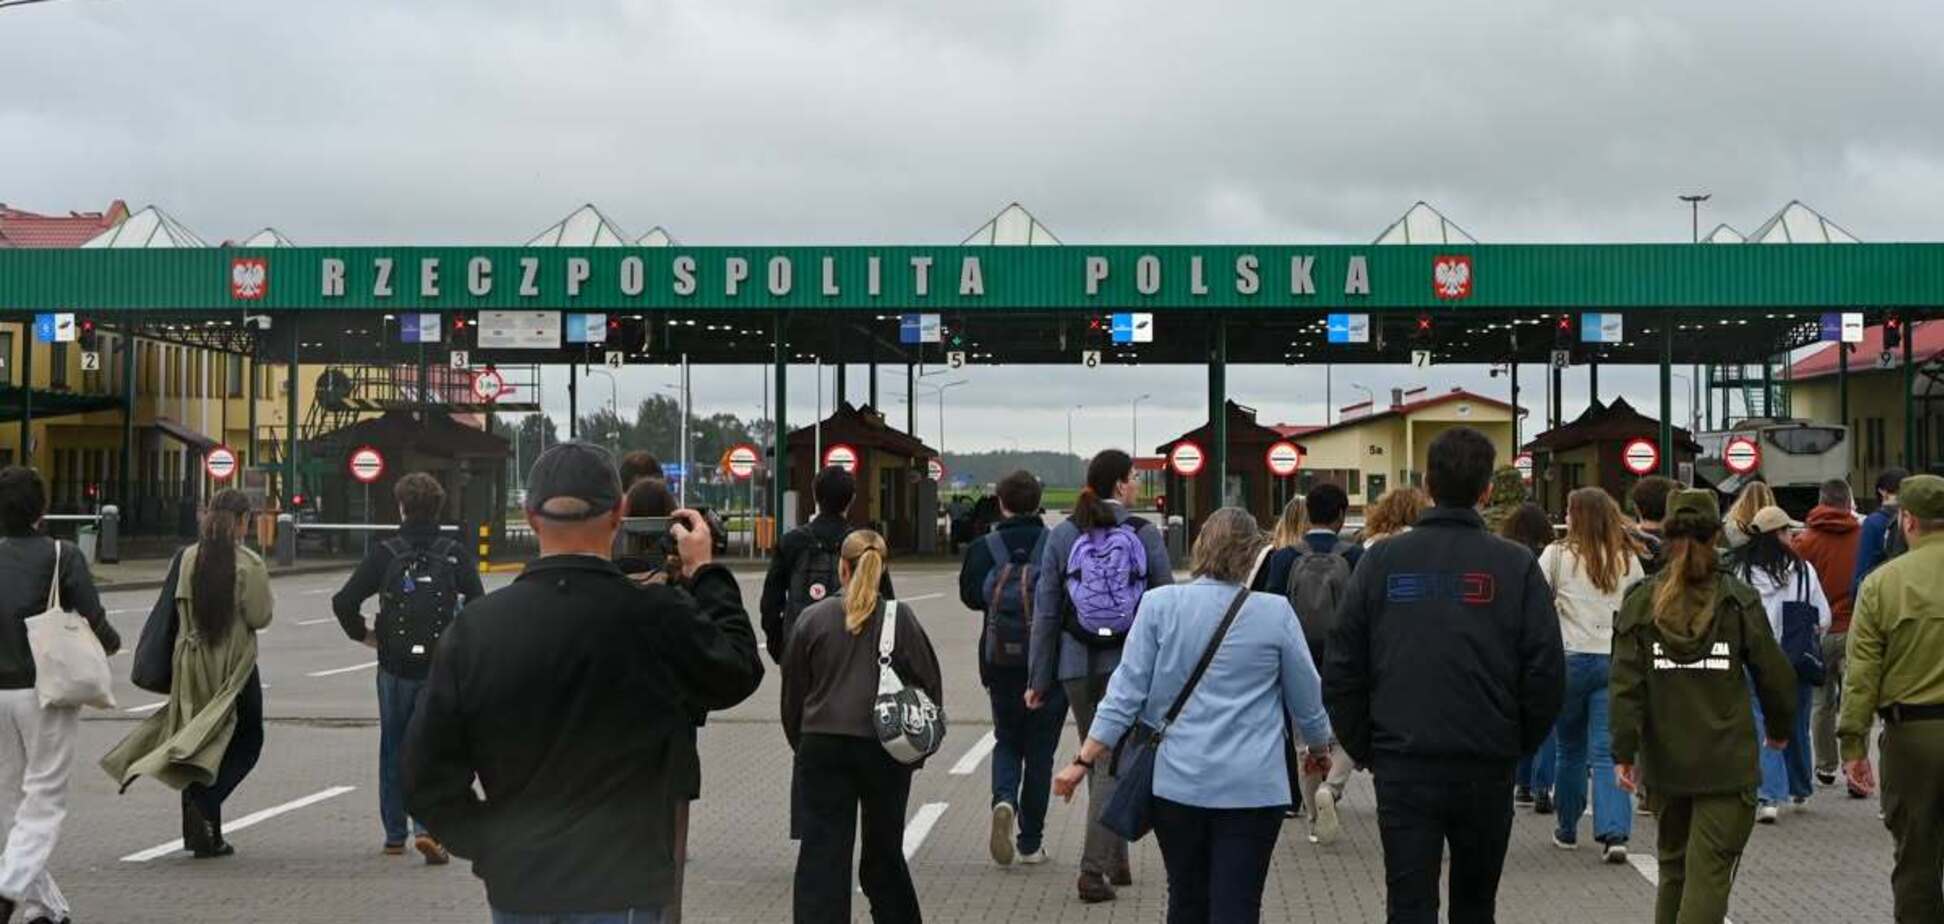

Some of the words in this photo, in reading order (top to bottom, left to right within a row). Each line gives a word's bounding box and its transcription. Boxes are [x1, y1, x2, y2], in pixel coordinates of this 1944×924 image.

[321, 255, 985, 297] RZECZPOSPOLITA
[1085, 254, 1371, 296] POLSKA
[85, 352, 95, 369] 2
[454, 352, 465, 368] 3
[609, 352, 619, 368] 4
[952, 352, 961, 369] 5
[1086, 352, 1097, 368] 6
[1416, 352, 1426, 368] 7
[1556, 351, 1565, 367] 8
[1880, 351, 1892, 367] 9
